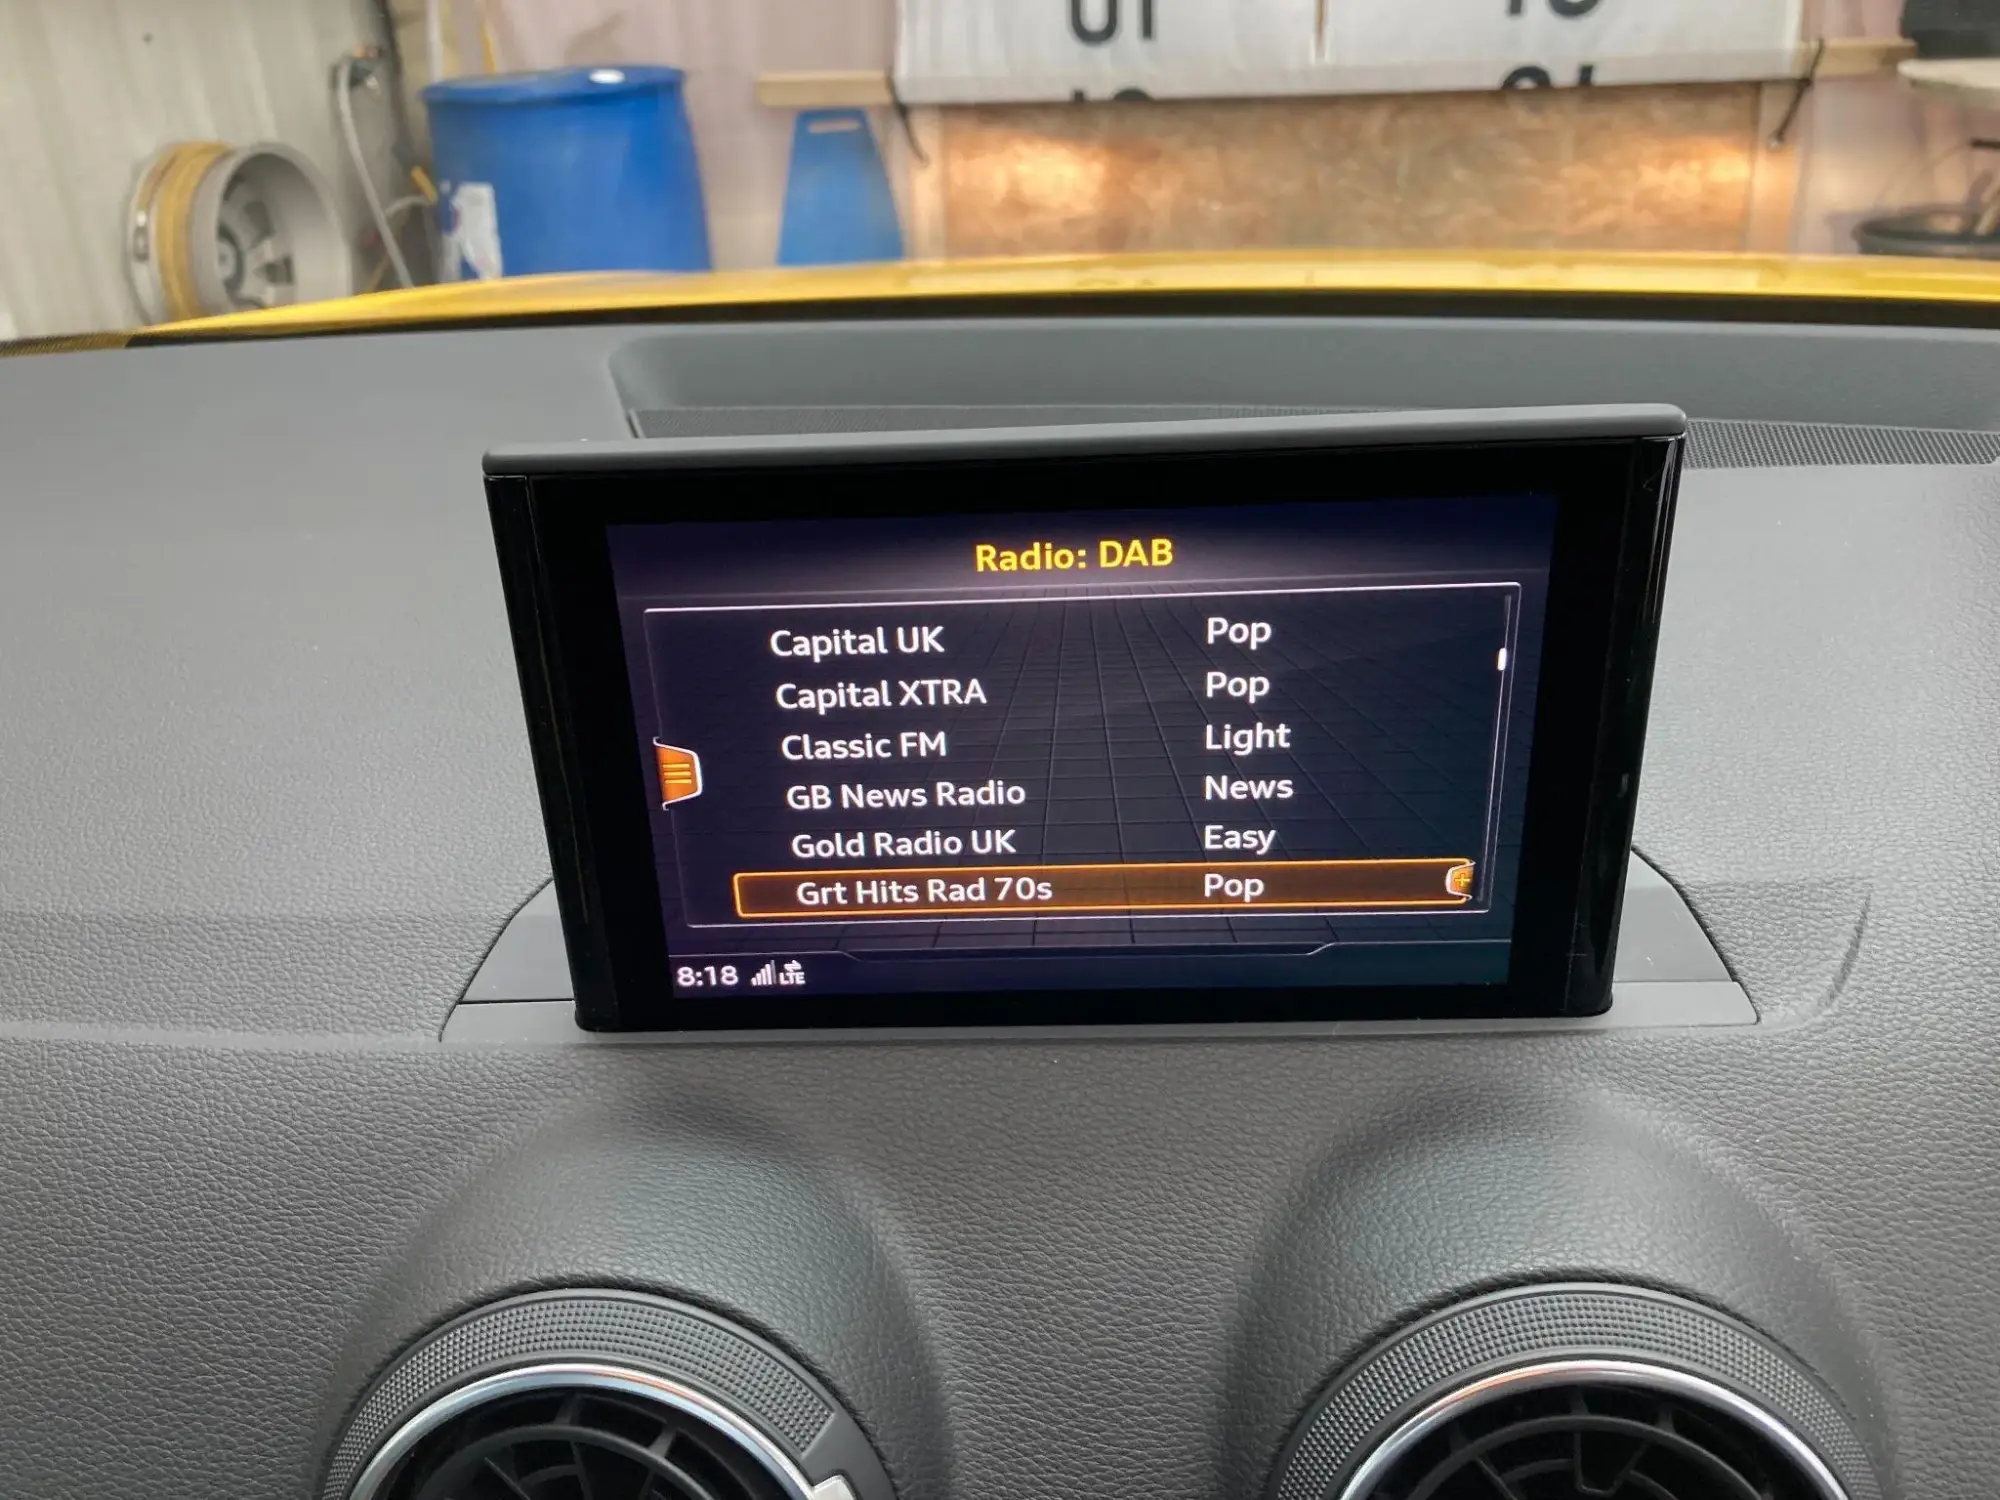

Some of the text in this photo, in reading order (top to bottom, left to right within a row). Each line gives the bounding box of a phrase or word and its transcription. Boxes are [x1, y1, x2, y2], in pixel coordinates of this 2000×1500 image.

[975, 537, 1174, 573] Radio: DAB
[769, 624, 946, 664] Capital UK
[1206, 615, 1273, 652] Pop
[775, 677, 989, 717] Capital XTRA
[1205, 670, 1271, 705] Pop
[780, 730, 948, 762] Classic FM
[1204, 720, 1293, 757] Light
[785, 778, 1027, 811] GB News Radio
[1204, 774, 1295, 802] News
[790, 828, 1018, 859] Gold Radio UK
[1203, 823, 1278, 856] Easy
[795, 875, 1054, 906] Grt Hits Rad 70s
[1203, 872, 1265, 904] Pop
[676, 964, 740, 988] 8:18
[778, 971, 806, 986] LTE
